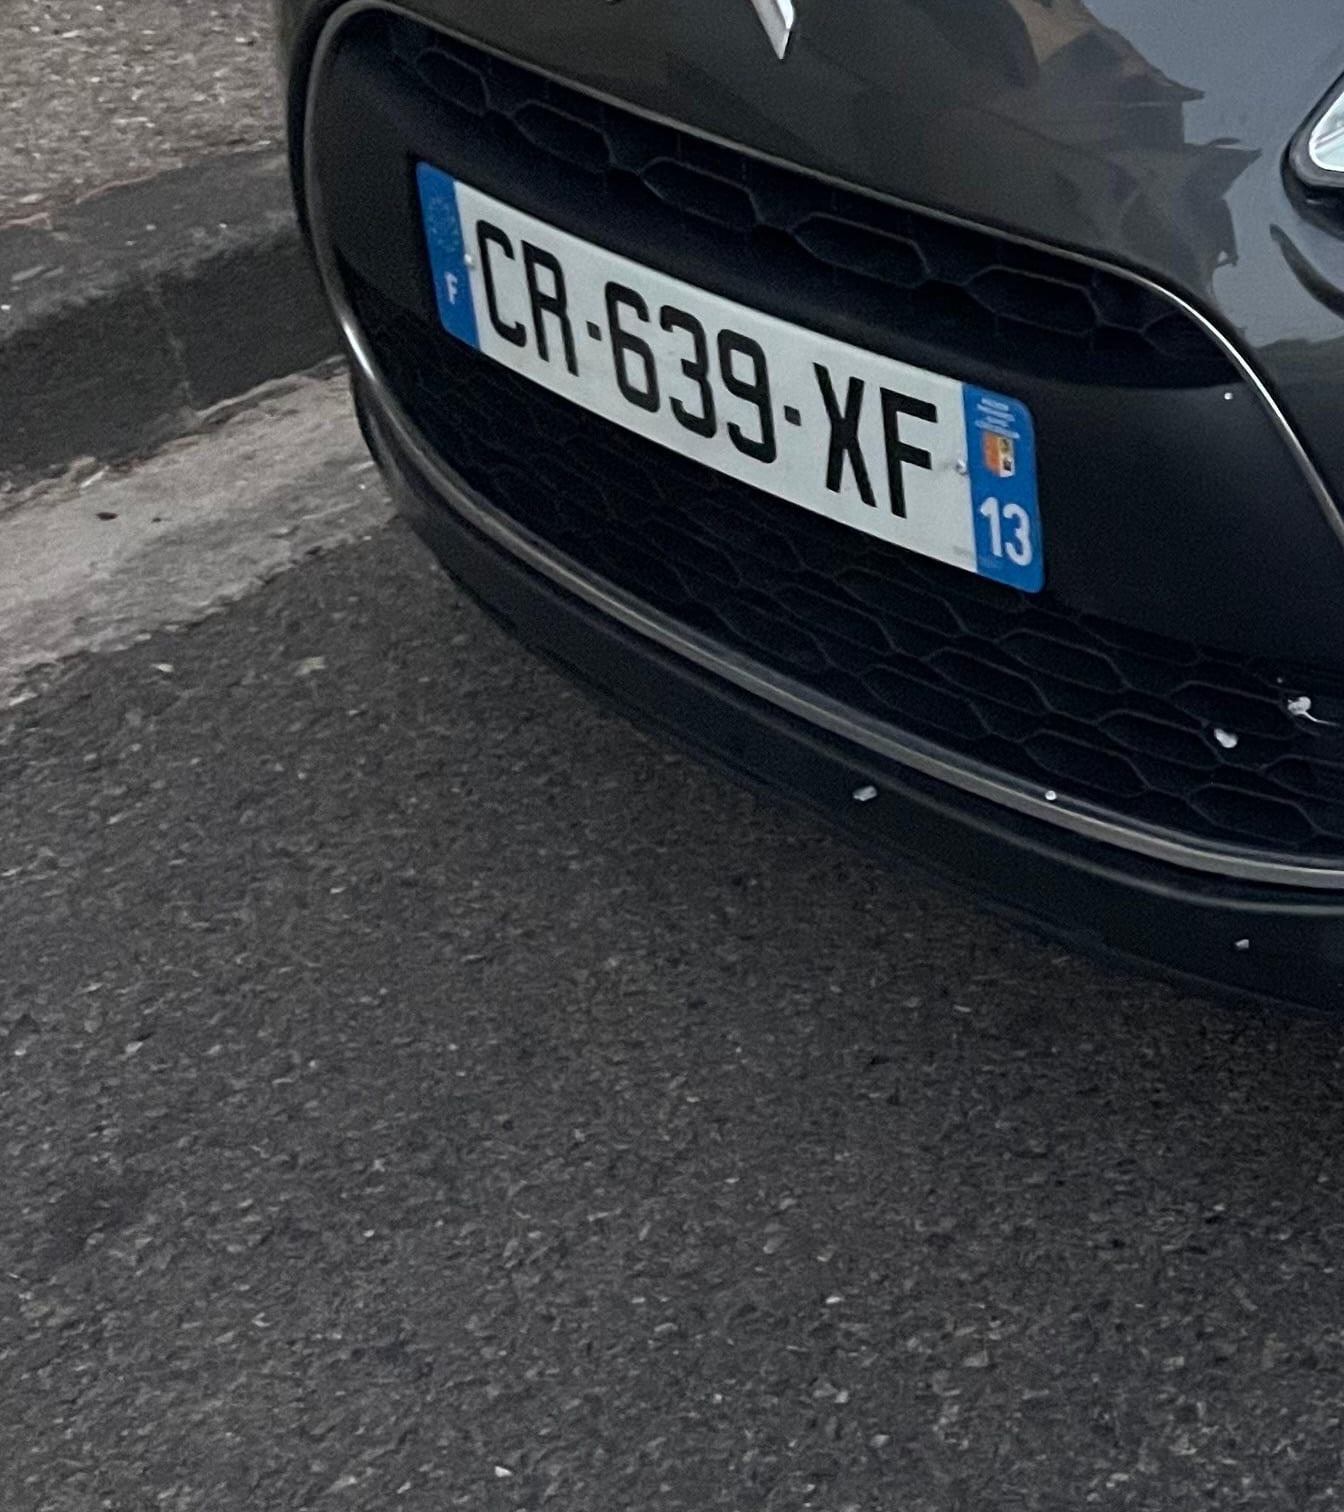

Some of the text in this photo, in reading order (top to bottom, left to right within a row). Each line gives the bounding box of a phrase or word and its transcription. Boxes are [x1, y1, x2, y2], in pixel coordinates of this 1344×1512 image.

[444, 271, 458, 305] F
[476, 219, 938, 519] CR-639-XF
[979, 495, 1033, 567] 13
